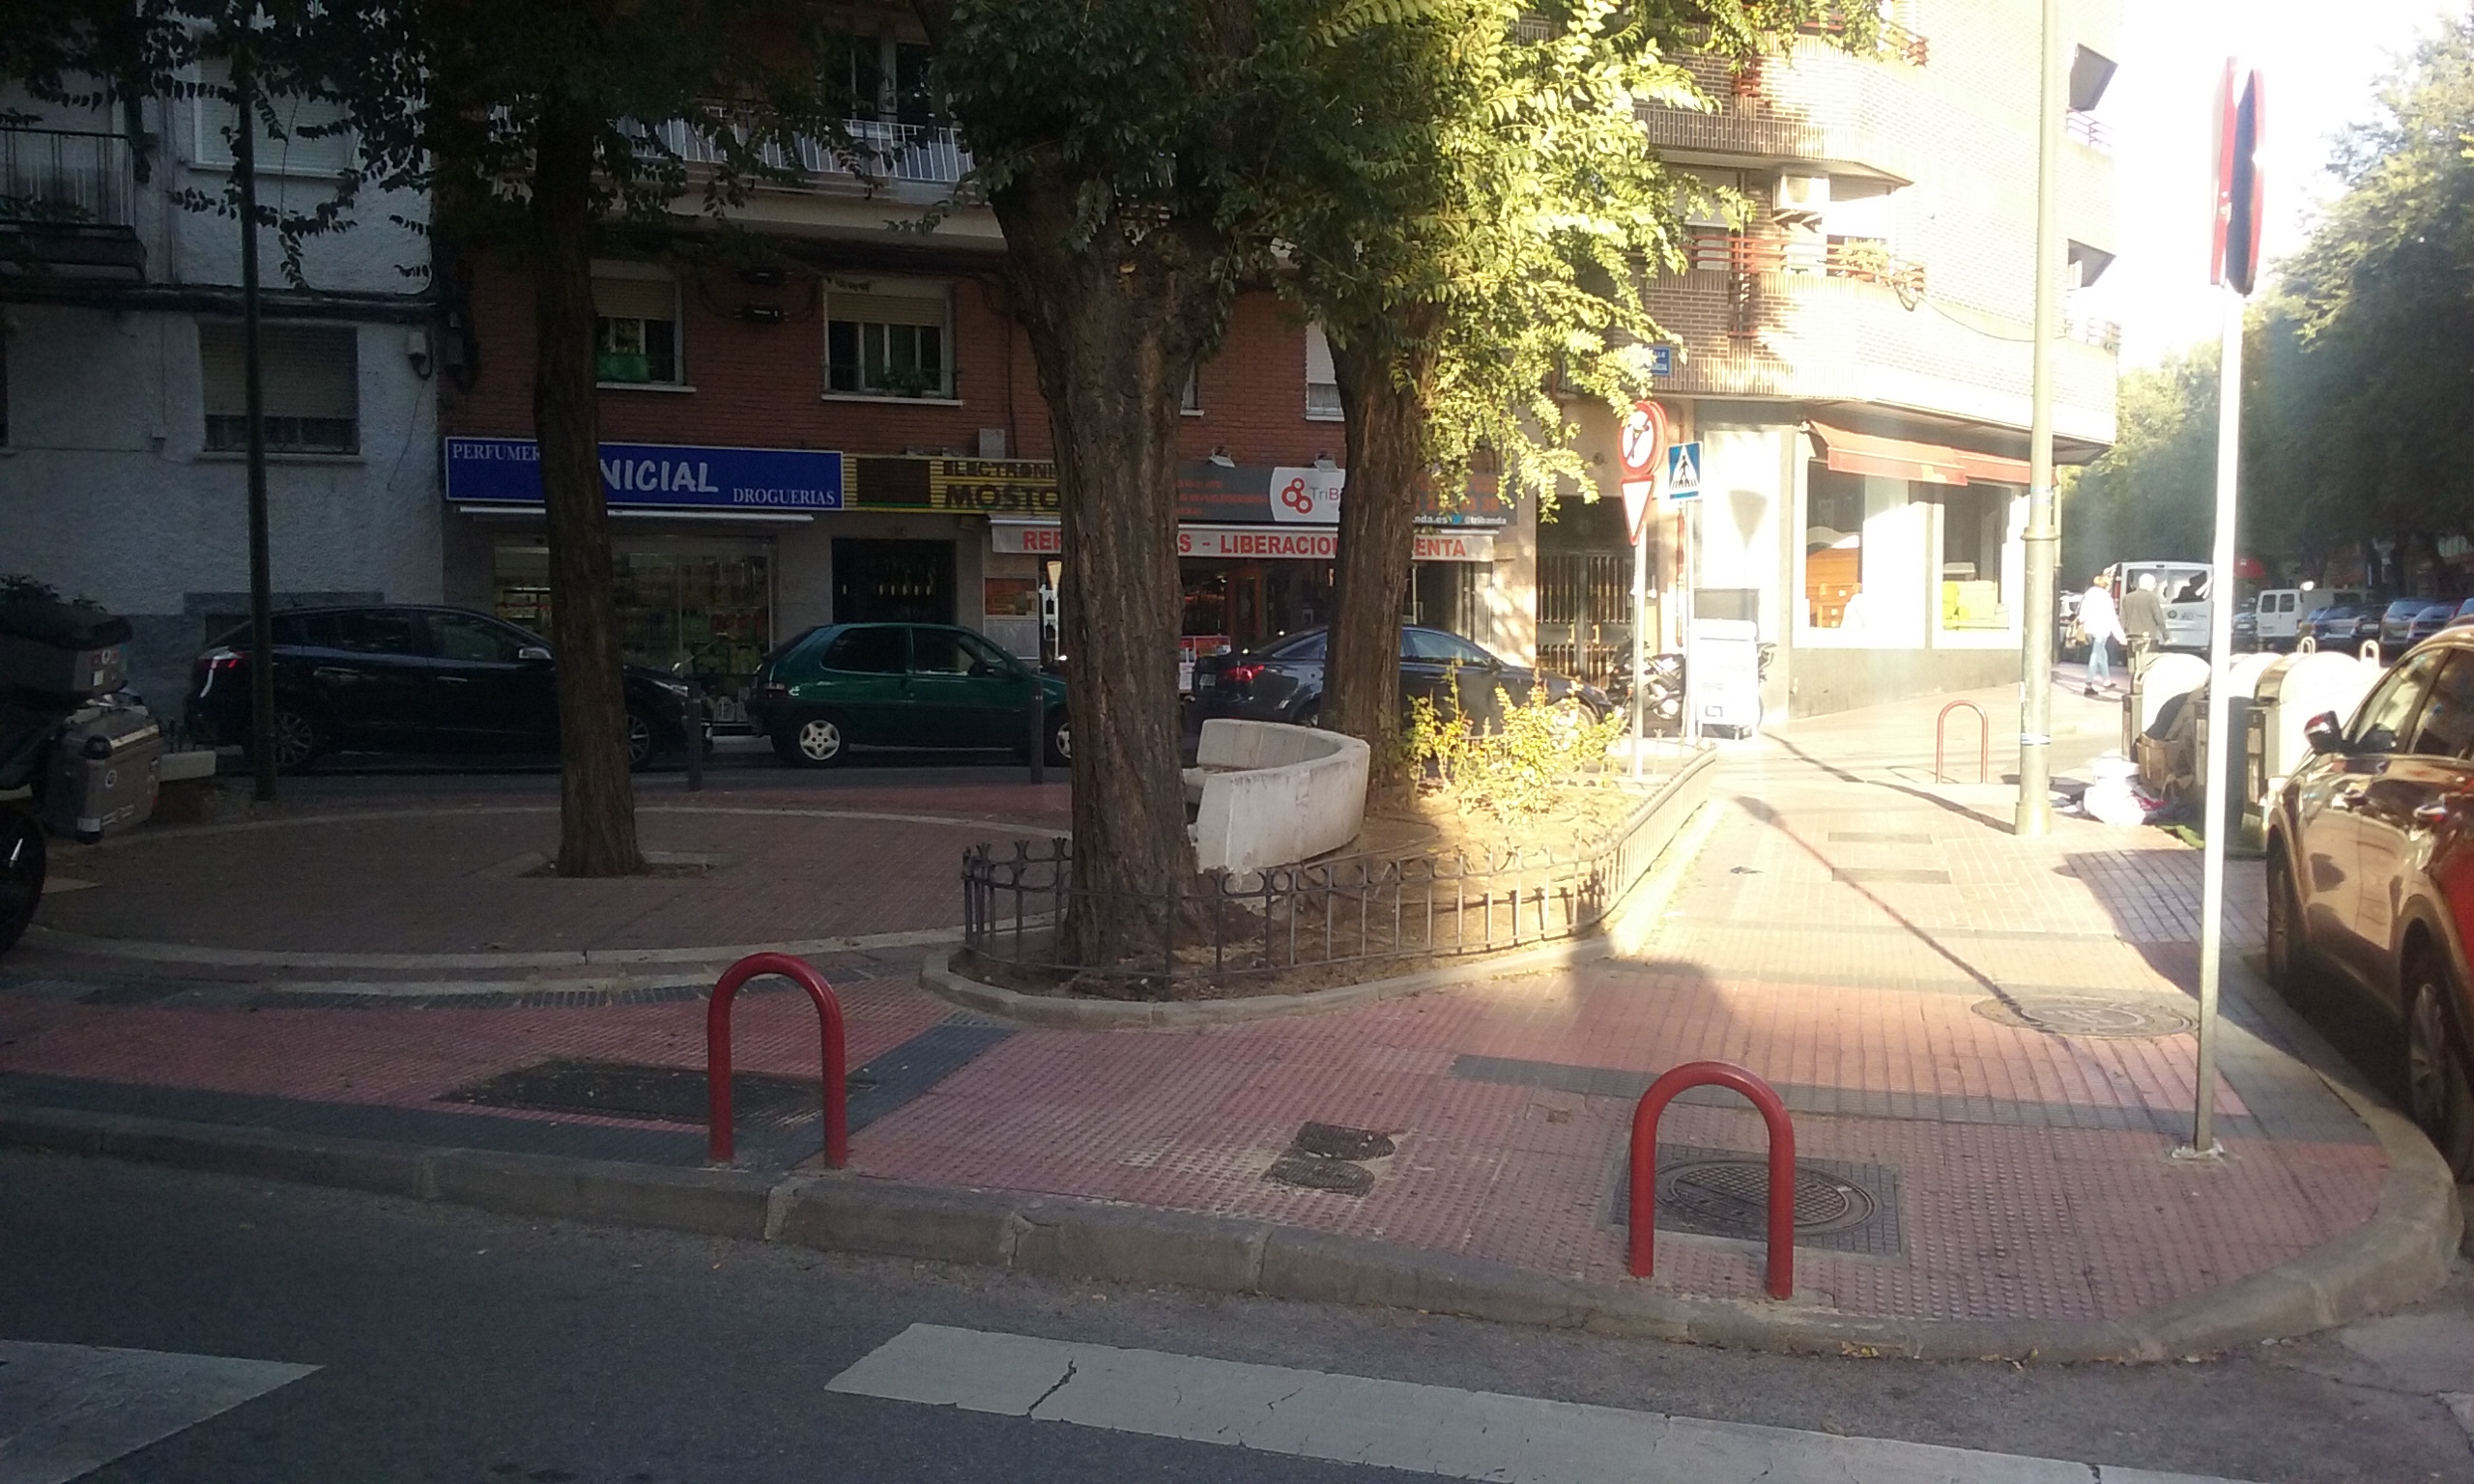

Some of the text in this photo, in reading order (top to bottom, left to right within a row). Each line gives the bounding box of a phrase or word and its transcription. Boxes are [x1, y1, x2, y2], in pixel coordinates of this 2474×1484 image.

[599, 459, 719, 493] NICIAL
[733, 488, 836, 505] DROGUERIAS
[1464, 515, 1508, 526] @tribanda
[1415, 538, 1466, 556] ENTA
